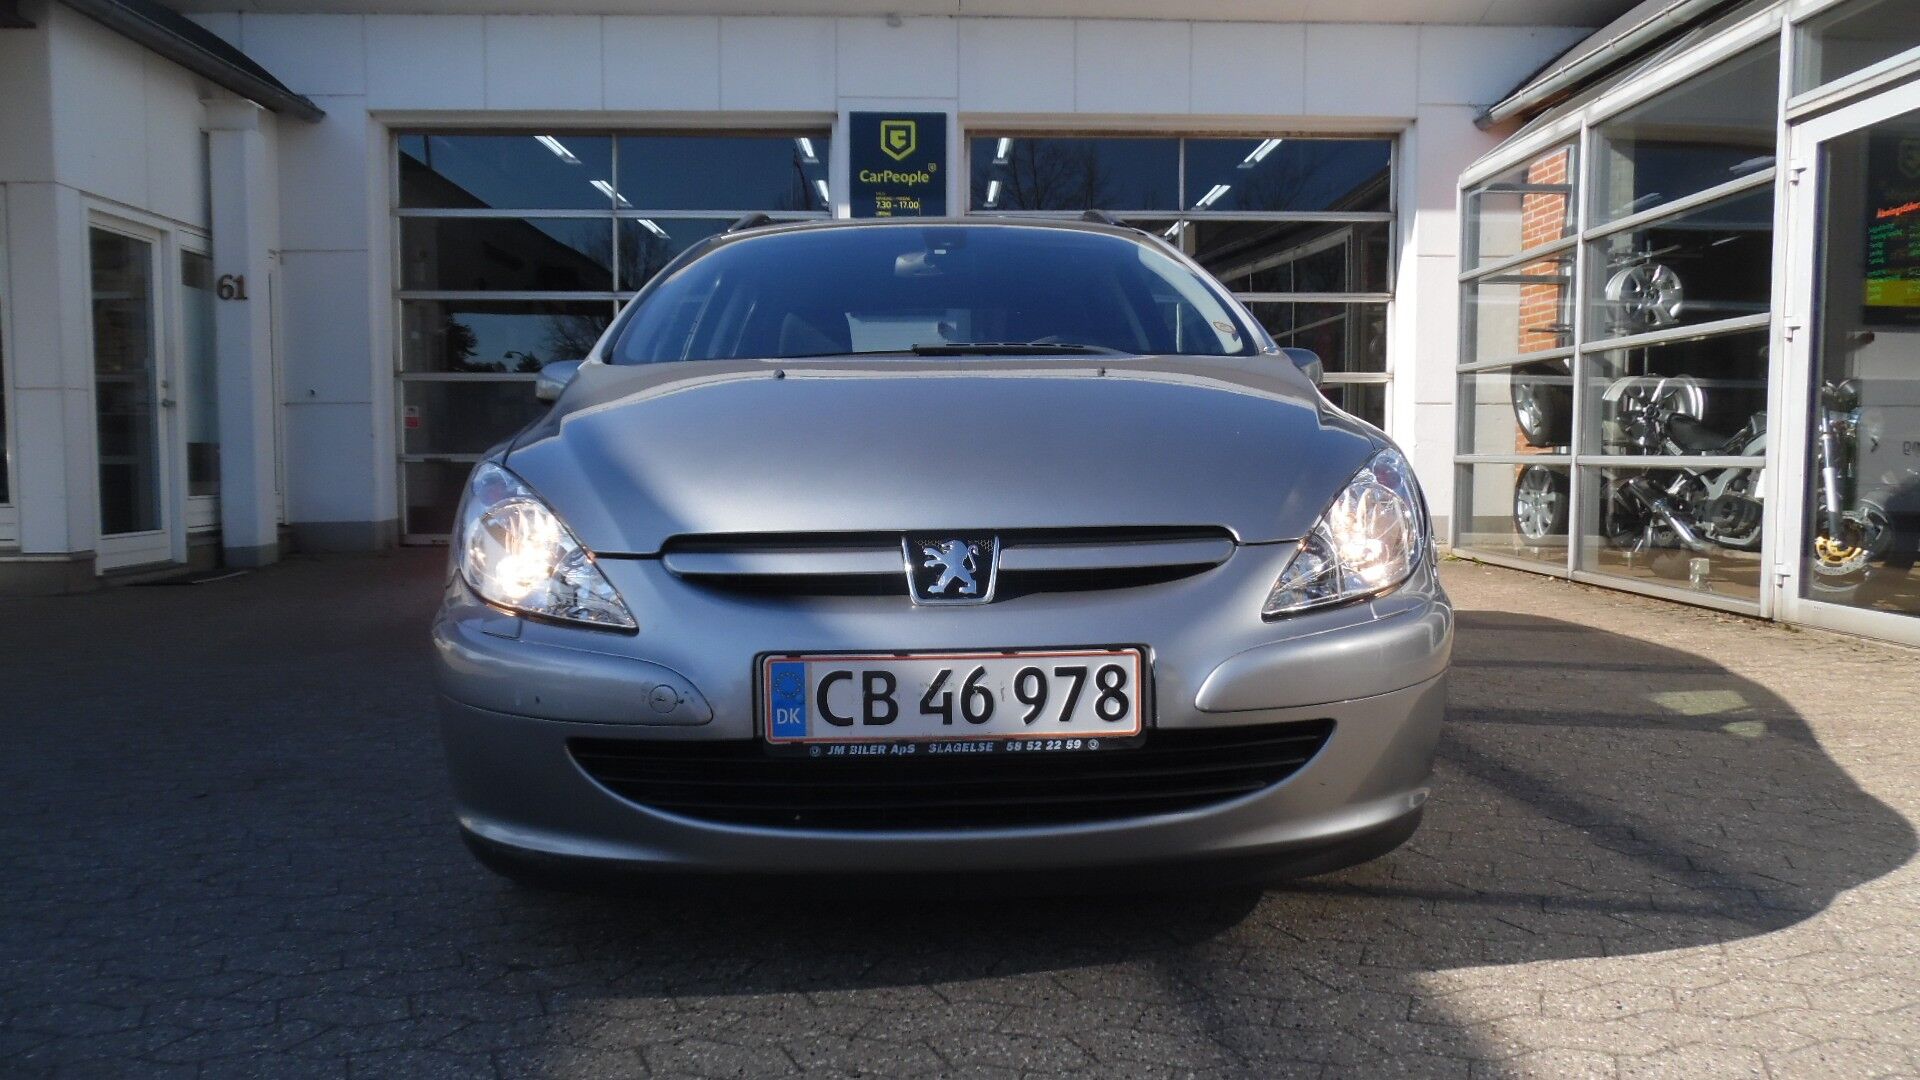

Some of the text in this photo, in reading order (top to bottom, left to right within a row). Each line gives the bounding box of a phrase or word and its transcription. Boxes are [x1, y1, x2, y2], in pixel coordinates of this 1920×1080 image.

[860, 169, 929, 186] CarPeople
[217, 274, 248, 300] 61
[816, 663, 1129, 727] CB 46 978
[776, 708, 800, 724] DK
[827, 739, 1082, 756] JM BILER ApS SLAGELSE 58 52 22 59
